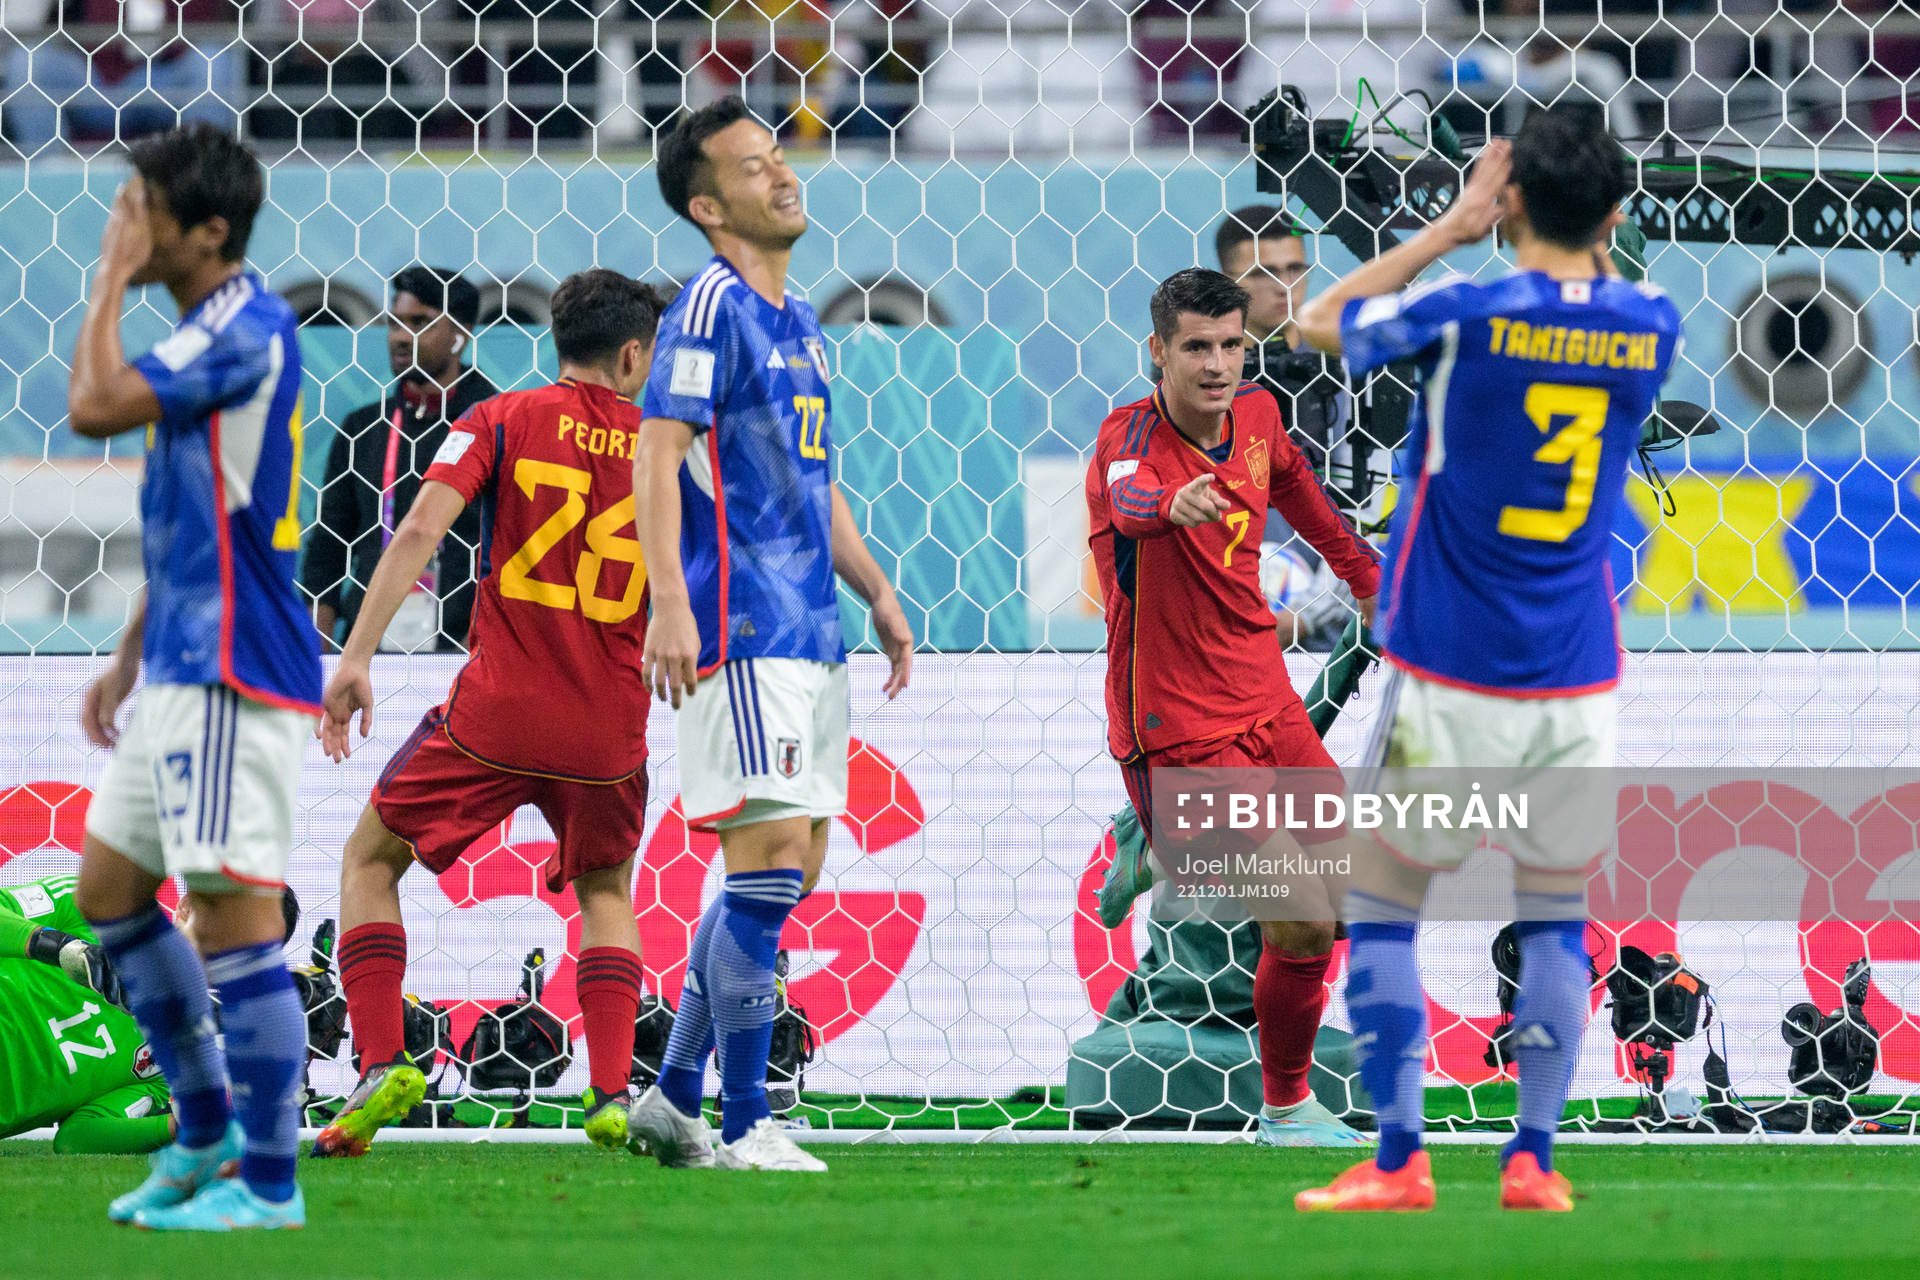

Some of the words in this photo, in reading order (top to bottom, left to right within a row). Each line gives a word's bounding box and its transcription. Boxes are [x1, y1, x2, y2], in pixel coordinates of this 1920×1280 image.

[1488, 316, 1658, 370] TANIGUCHI
[558, 414, 639, 460] PEDRI
[793, 395, 826, 460] 22
[1497, 382, 1610, 543] 3
[500, 458, 648, 624] 26
[1224, 511, 1249, 568] 7
[153, 751, 192, 819] 13
[48, 1001, 116, 1074] 12
